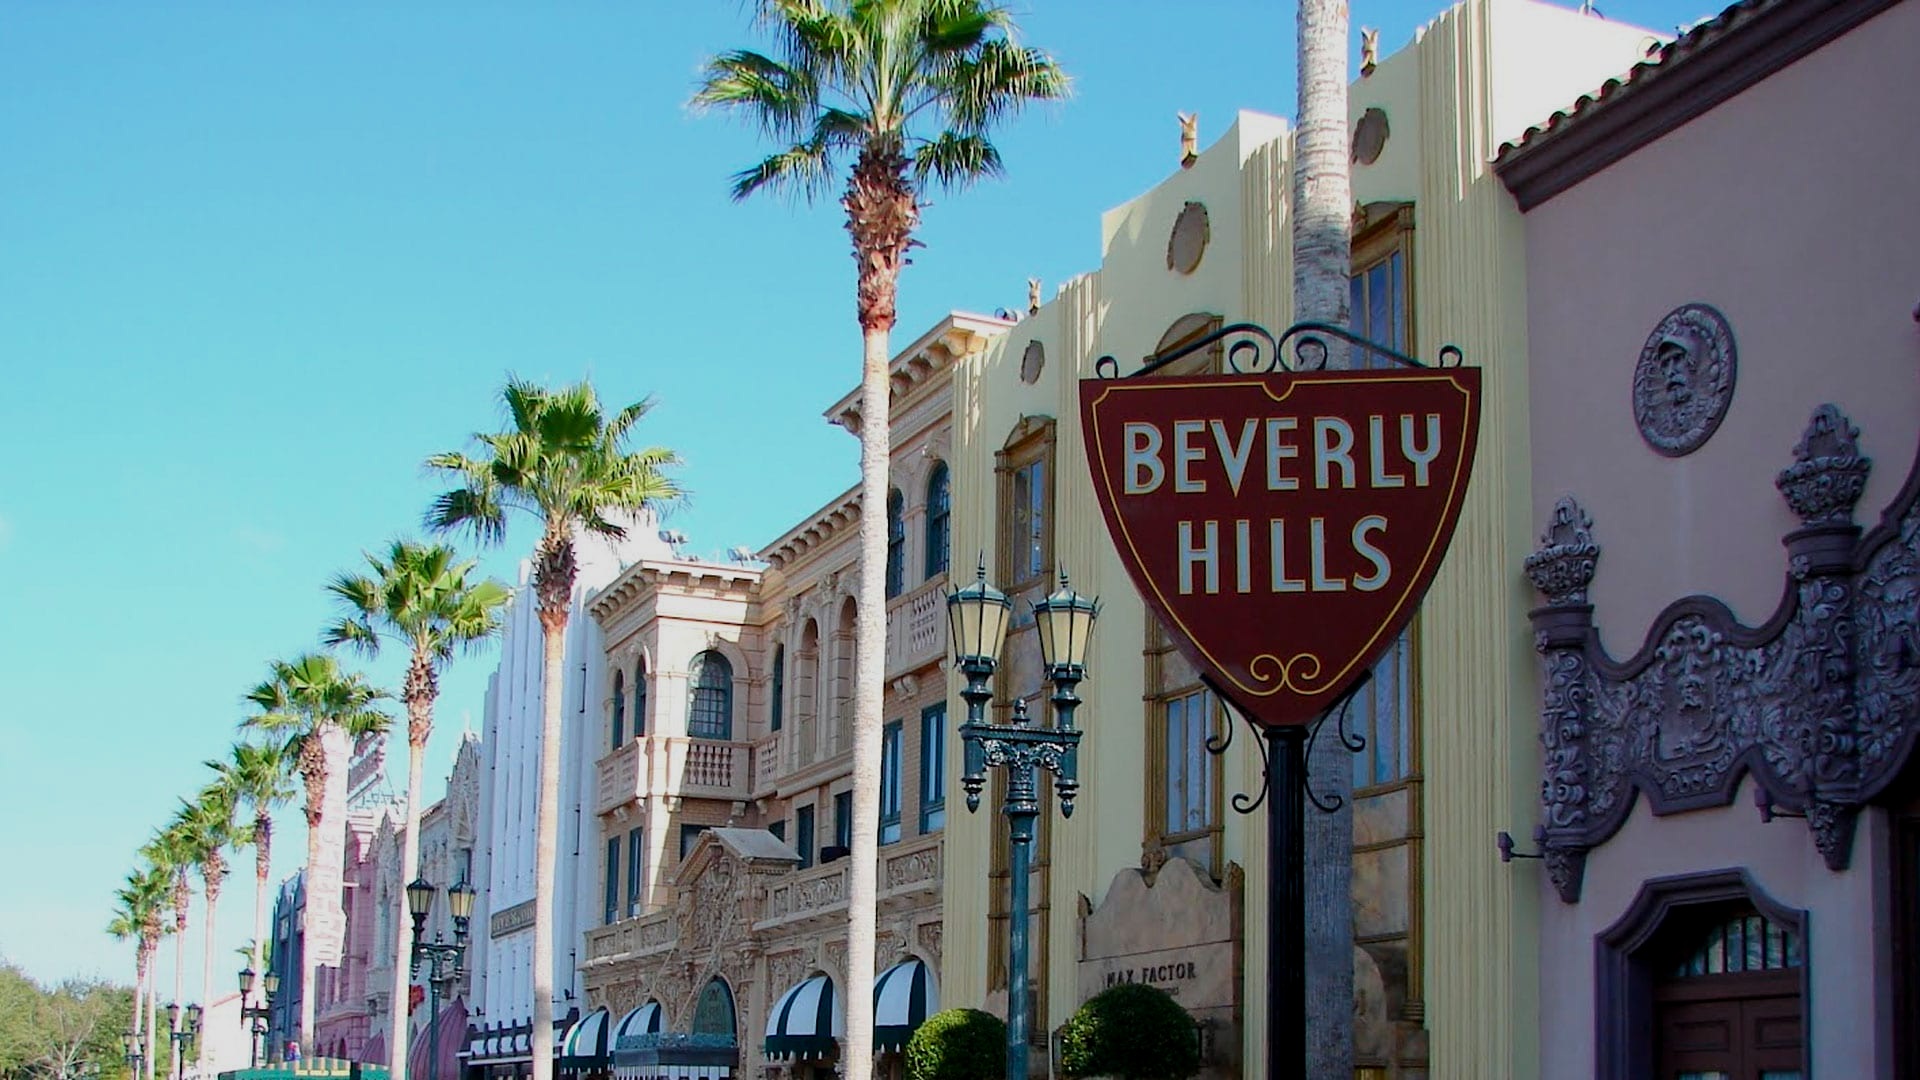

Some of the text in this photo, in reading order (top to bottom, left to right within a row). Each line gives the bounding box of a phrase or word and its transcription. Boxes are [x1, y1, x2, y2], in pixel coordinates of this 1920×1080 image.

[1123, 413, 1442, 498] BEVERLY
[1177, 514, 1392, 595] HILLS
[1107, 962, 1197, 987] MAX FACTOR
